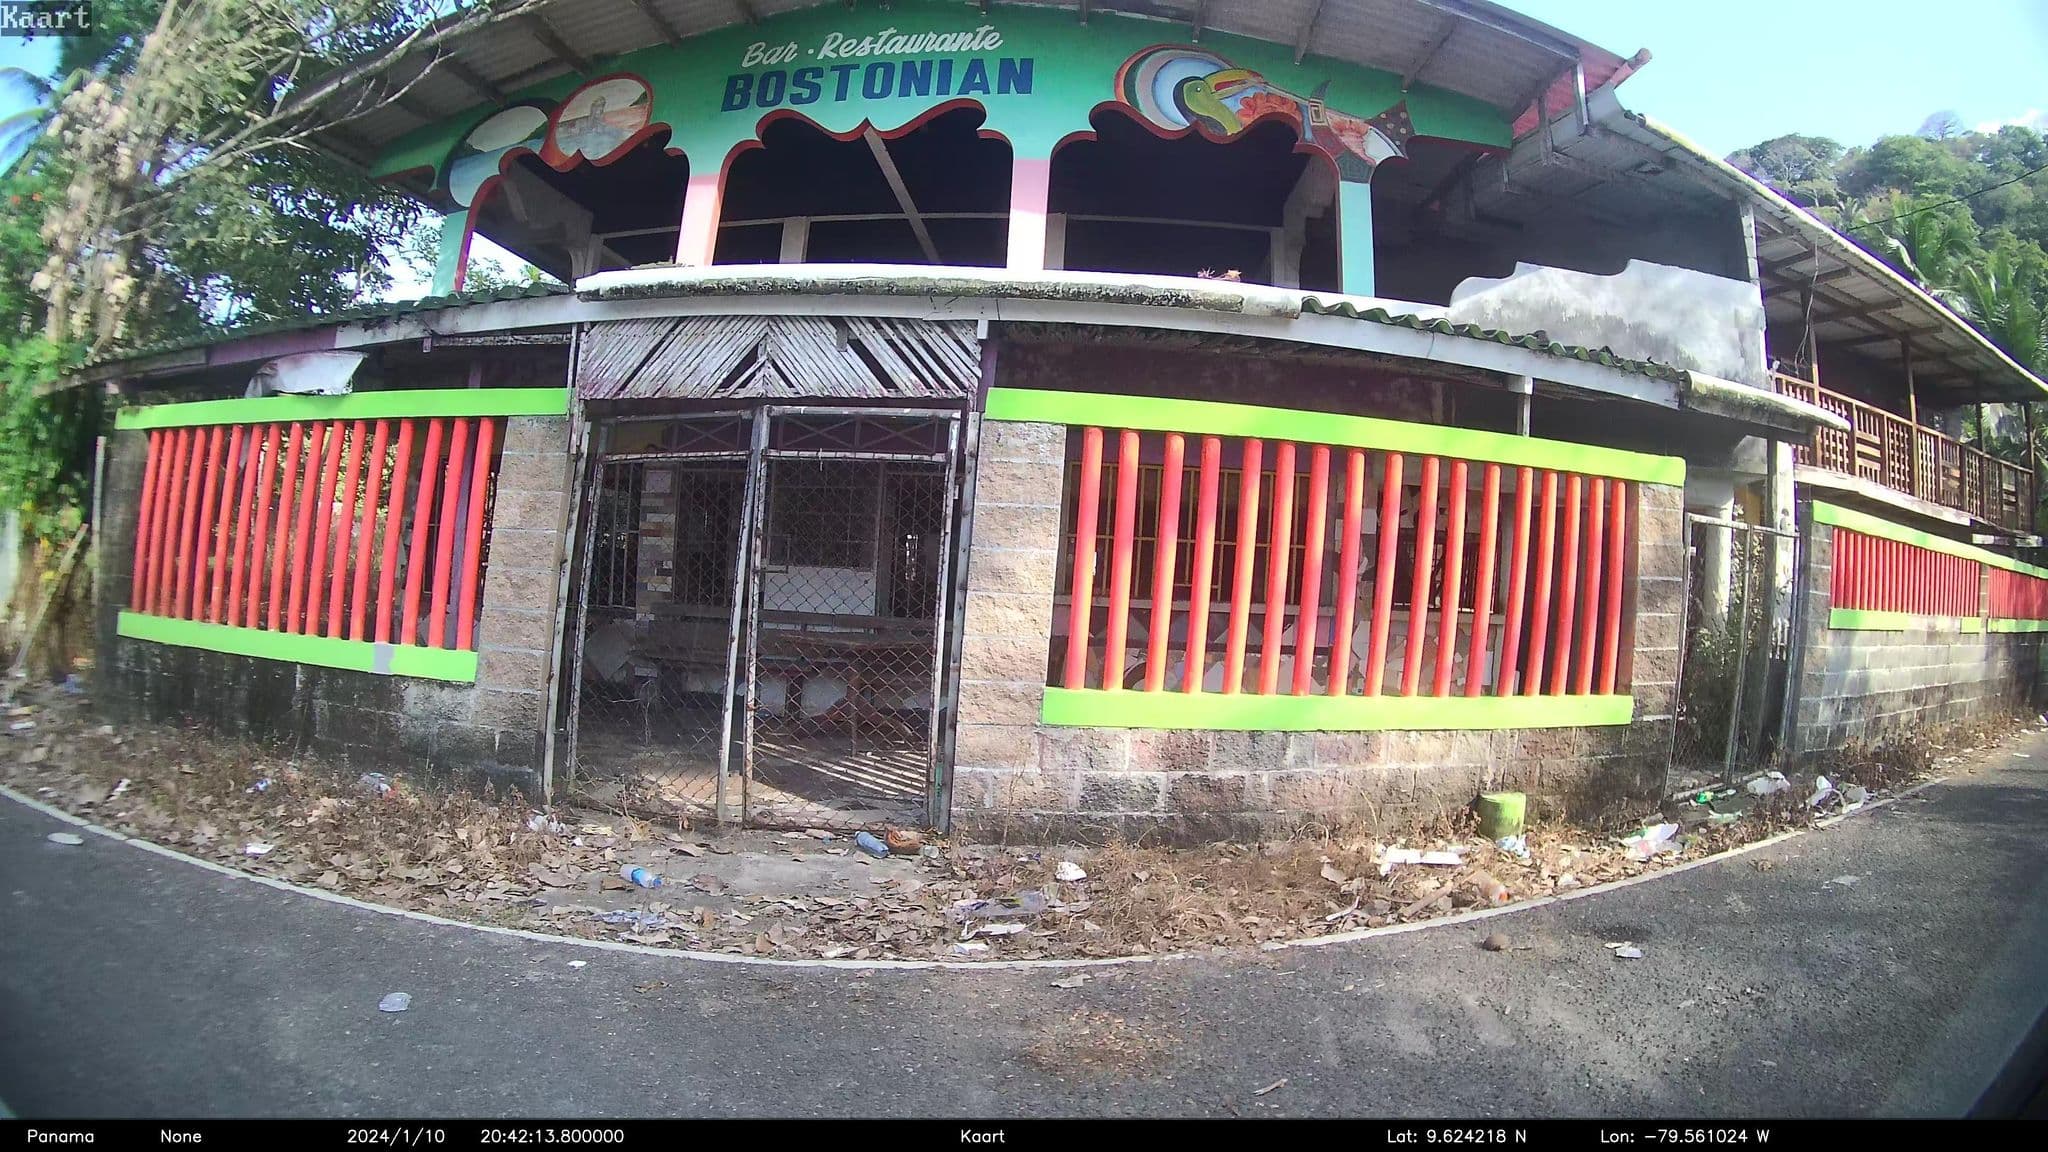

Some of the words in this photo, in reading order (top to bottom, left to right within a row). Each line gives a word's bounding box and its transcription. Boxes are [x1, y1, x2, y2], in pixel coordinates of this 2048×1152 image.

[741, 41, 798, 68] Bar
[816, 25, 1004, 60] Restaurante
[720, 57, 1034, 112] BOSTONIAN
